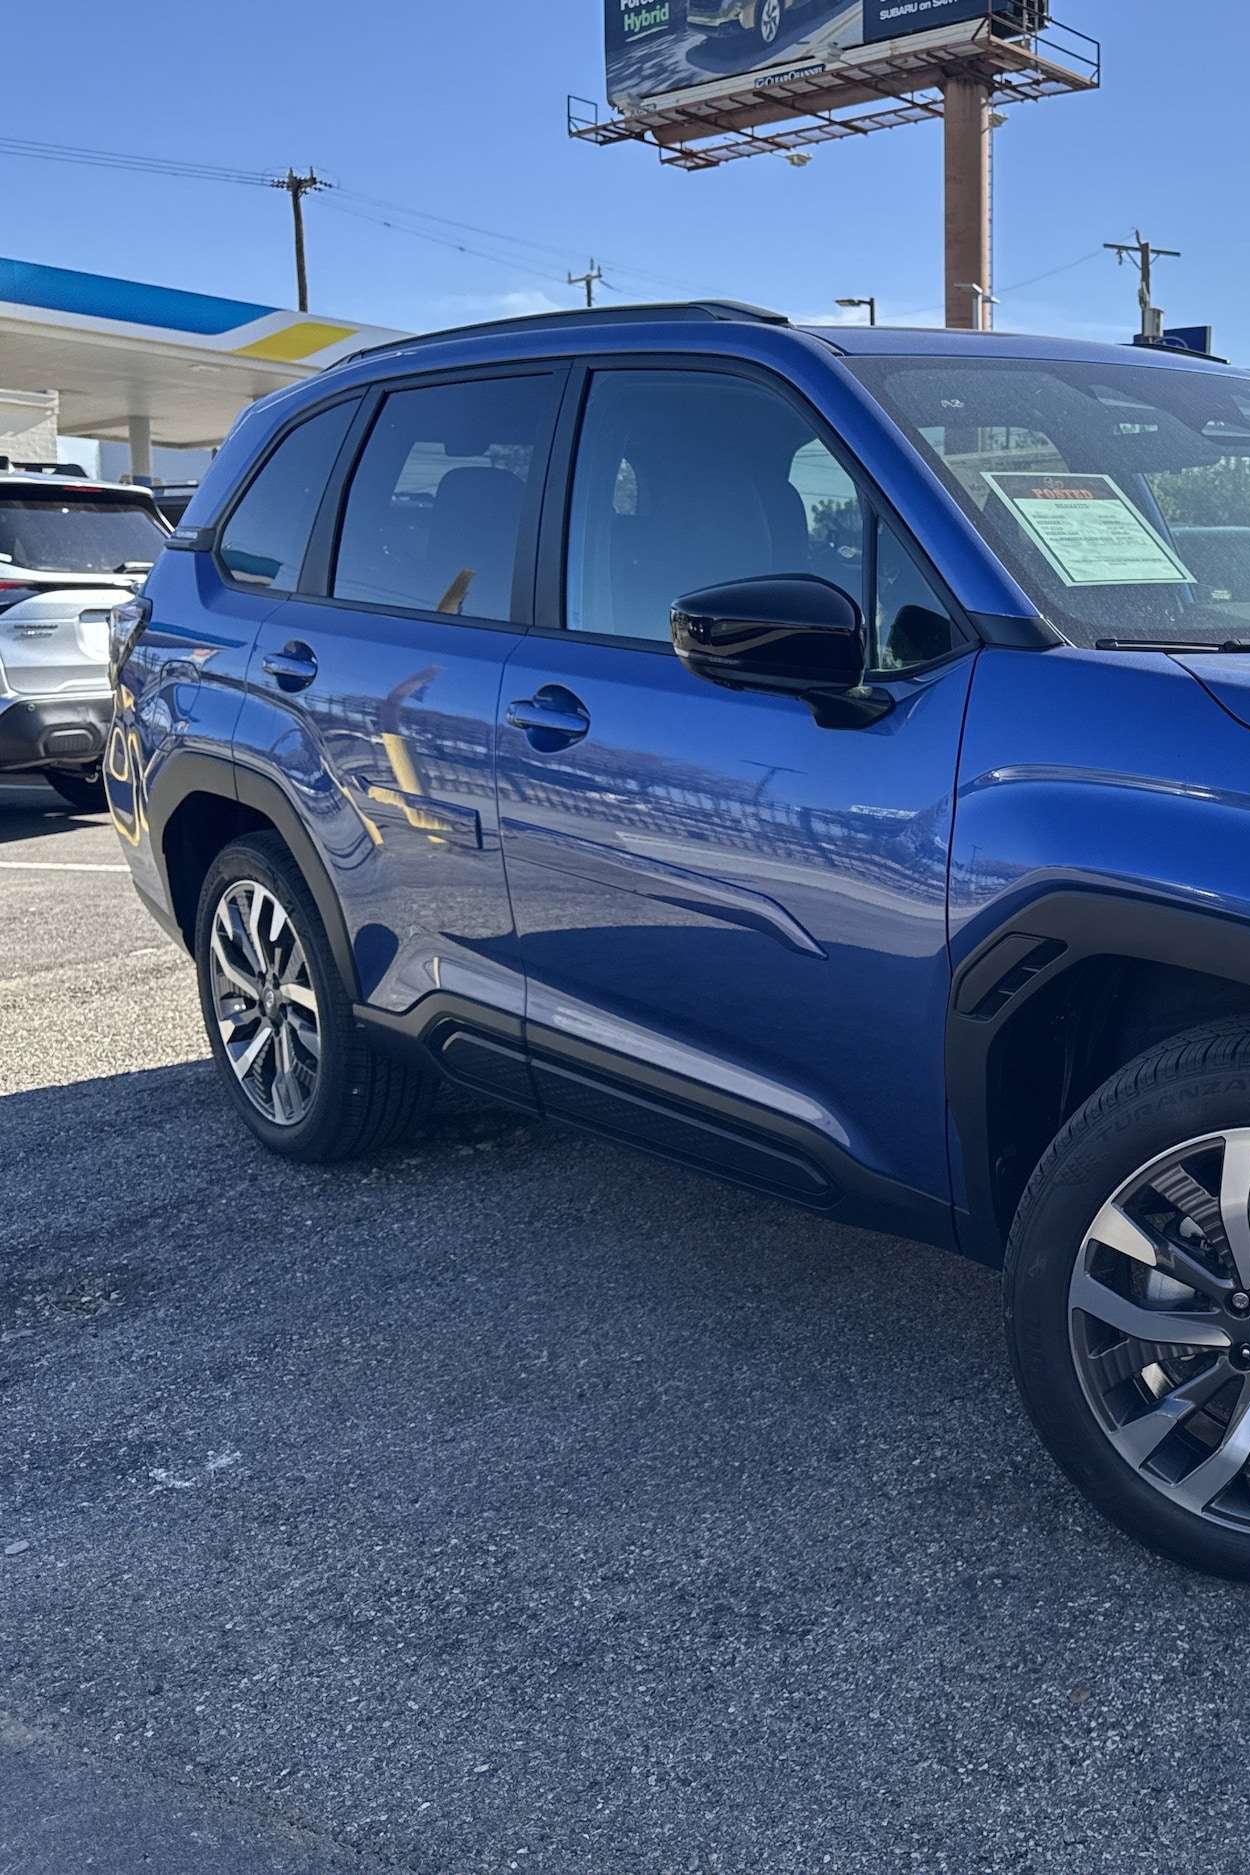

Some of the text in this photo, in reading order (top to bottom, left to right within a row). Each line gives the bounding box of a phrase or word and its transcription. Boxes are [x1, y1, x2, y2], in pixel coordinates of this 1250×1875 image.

[624, 2, 670, 32] Hybrid
[879, 2, 918, 20] SUBARU
[919, 1, 931, 10] on
[1031, 488, 1094, 499] POSTED
[1093, 1078, 1247, 1142] TURANZA
